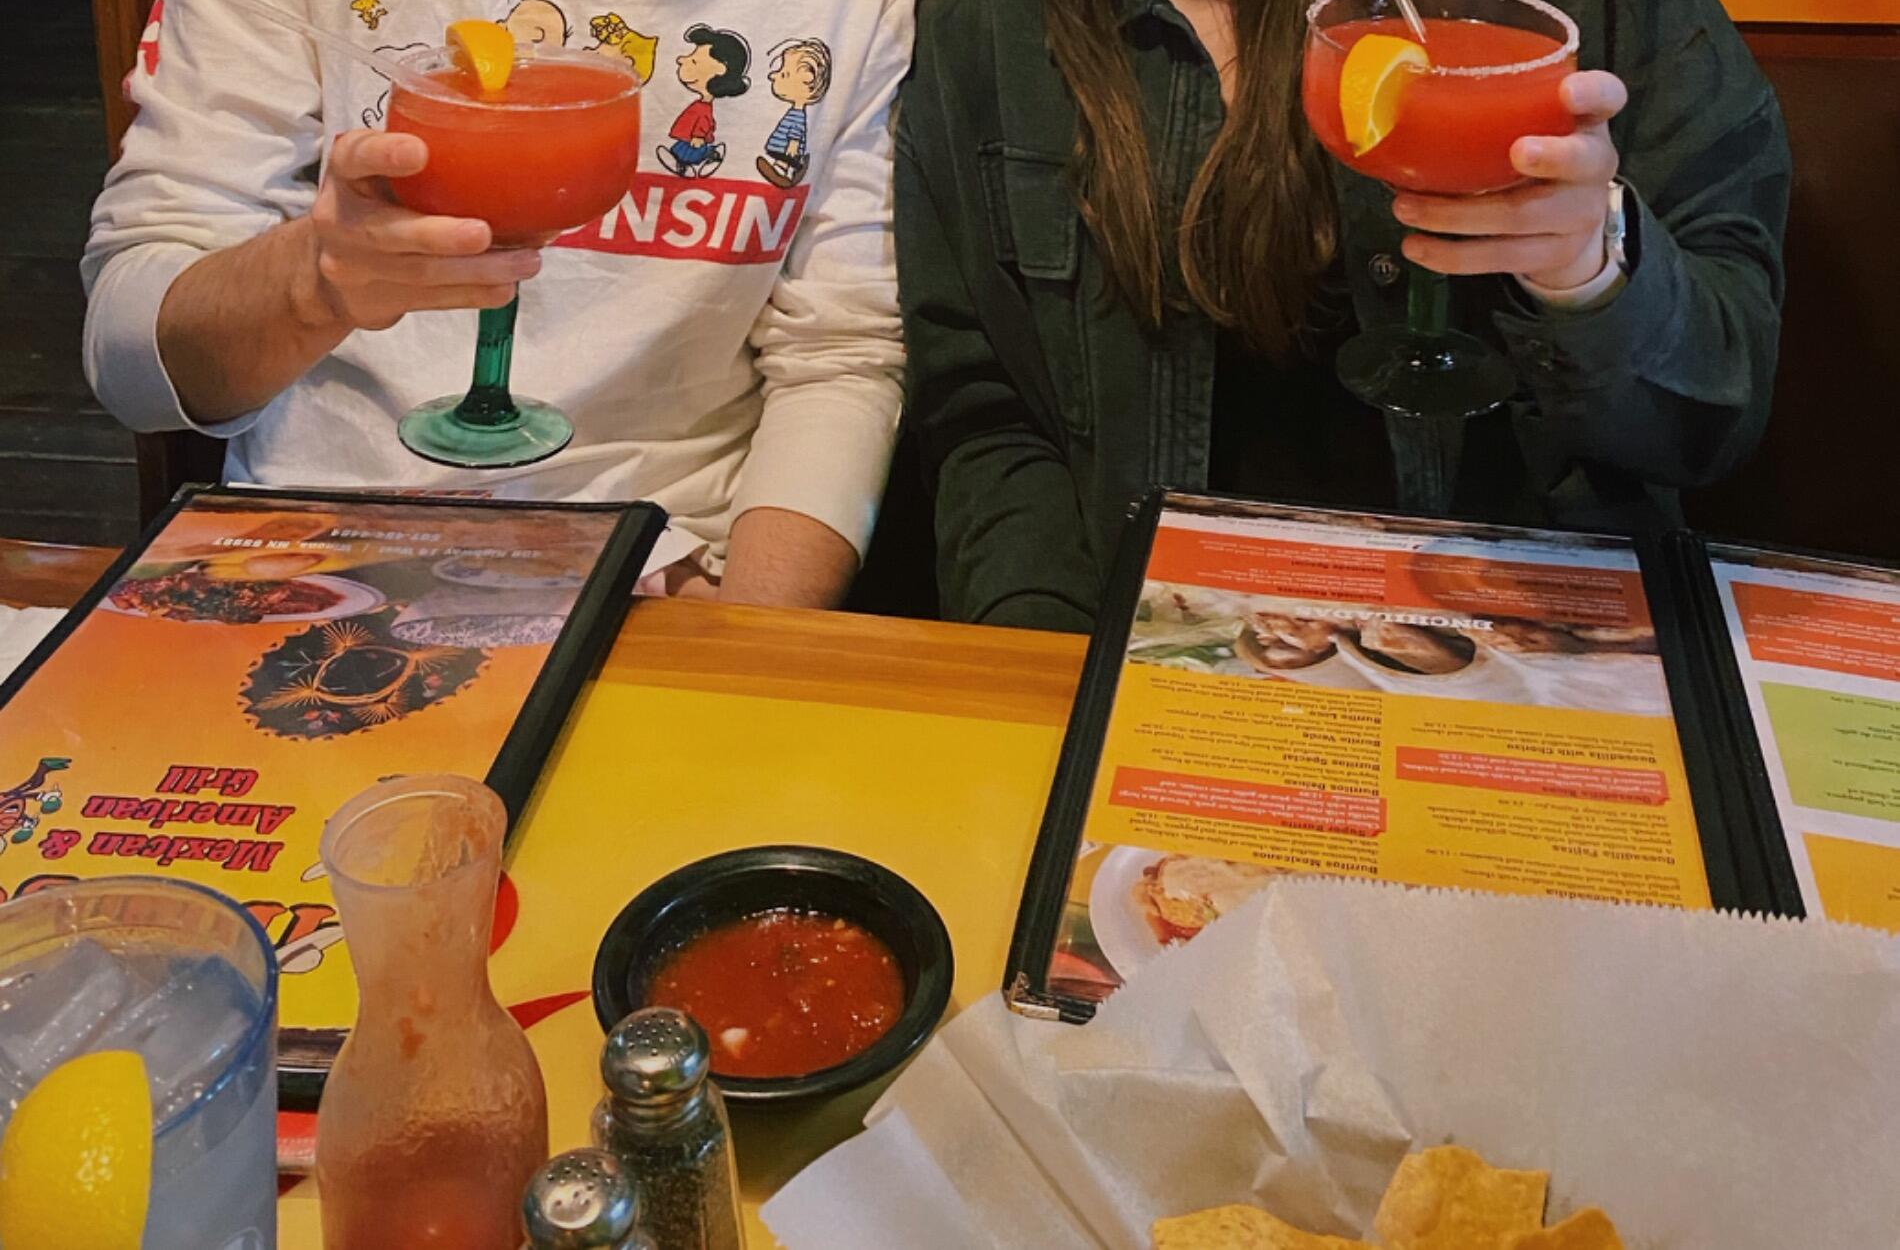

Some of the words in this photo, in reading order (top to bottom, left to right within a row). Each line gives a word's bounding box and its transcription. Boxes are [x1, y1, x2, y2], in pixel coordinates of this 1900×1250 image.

[558, 185, 797, 253] NSIN
[1294, 604, 1494, 631] ENCHILADAS
[155, 763, 259, 798] Grill
[80, 794, 296, 835] American
[37, 828, 81, 859] &
[86, 831, 285, 872] Mexican
